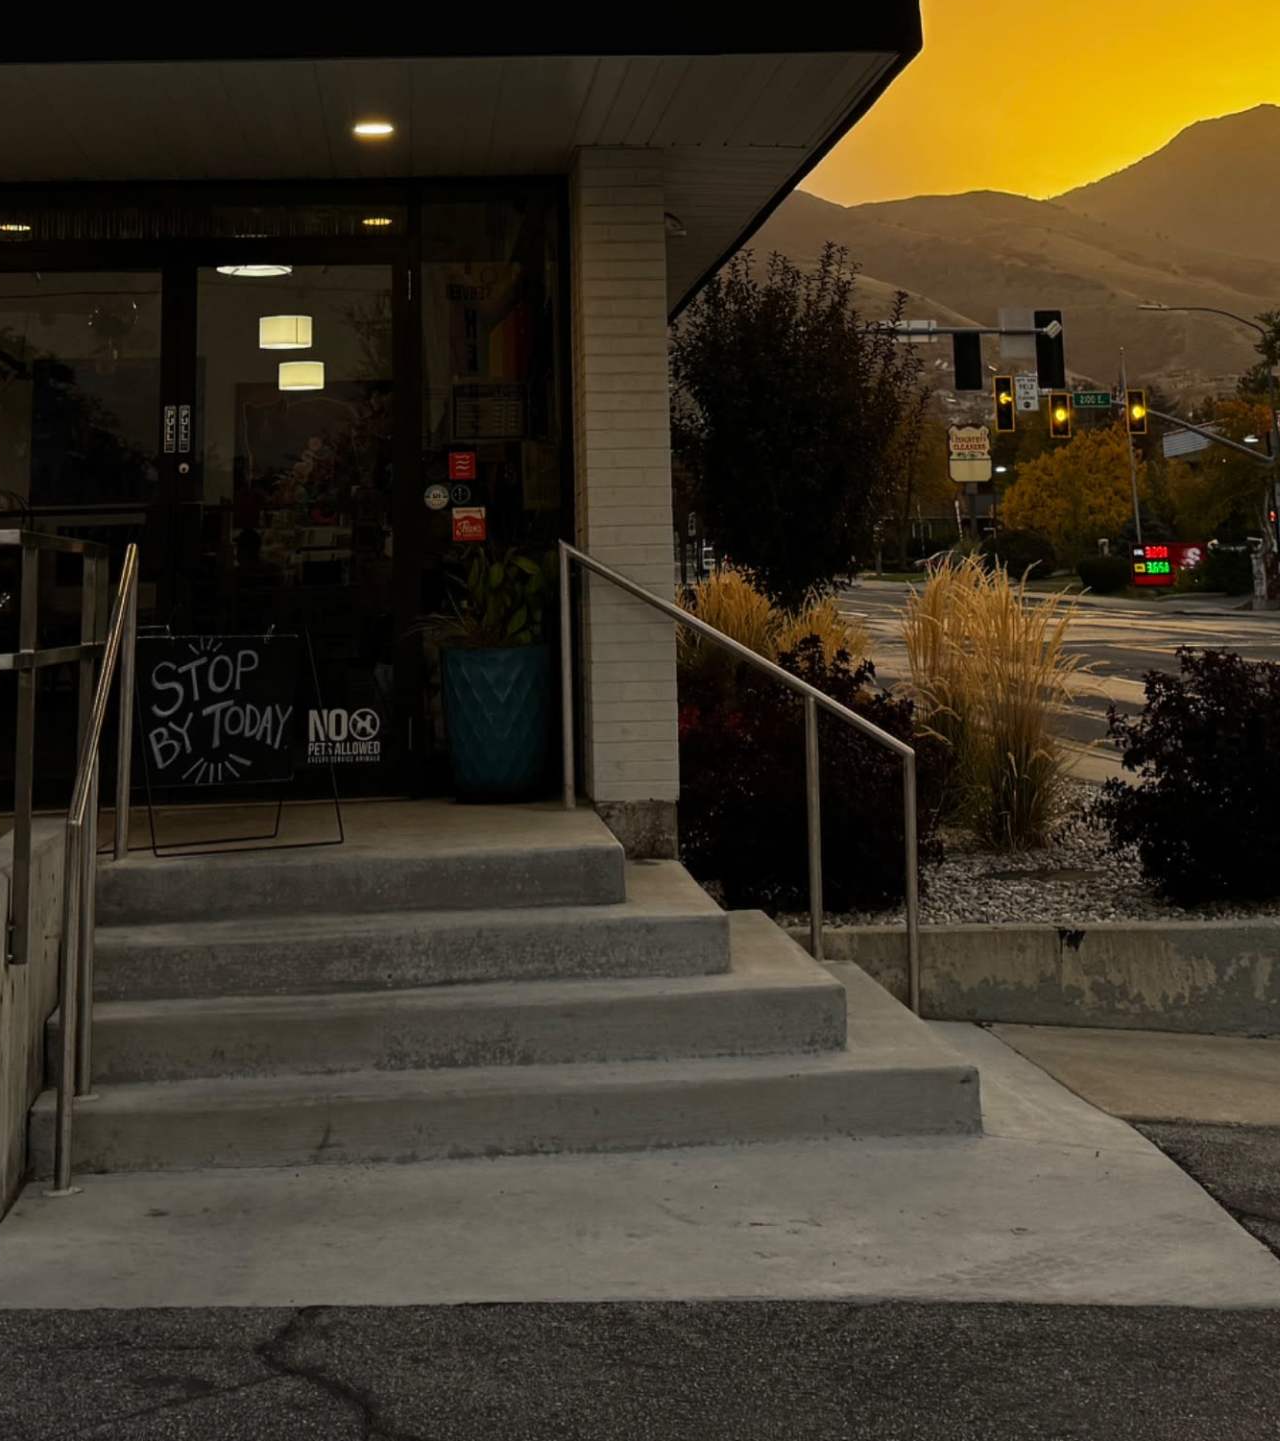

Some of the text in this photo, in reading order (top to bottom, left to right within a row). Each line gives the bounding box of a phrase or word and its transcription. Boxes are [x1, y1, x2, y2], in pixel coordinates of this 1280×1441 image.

[151, 649, 259, 717] STOP
[148, 712, 194, 769] BY
[308, 708, 348, 741] NO
[308, 741, 381, 756] PETS ALLOWED
